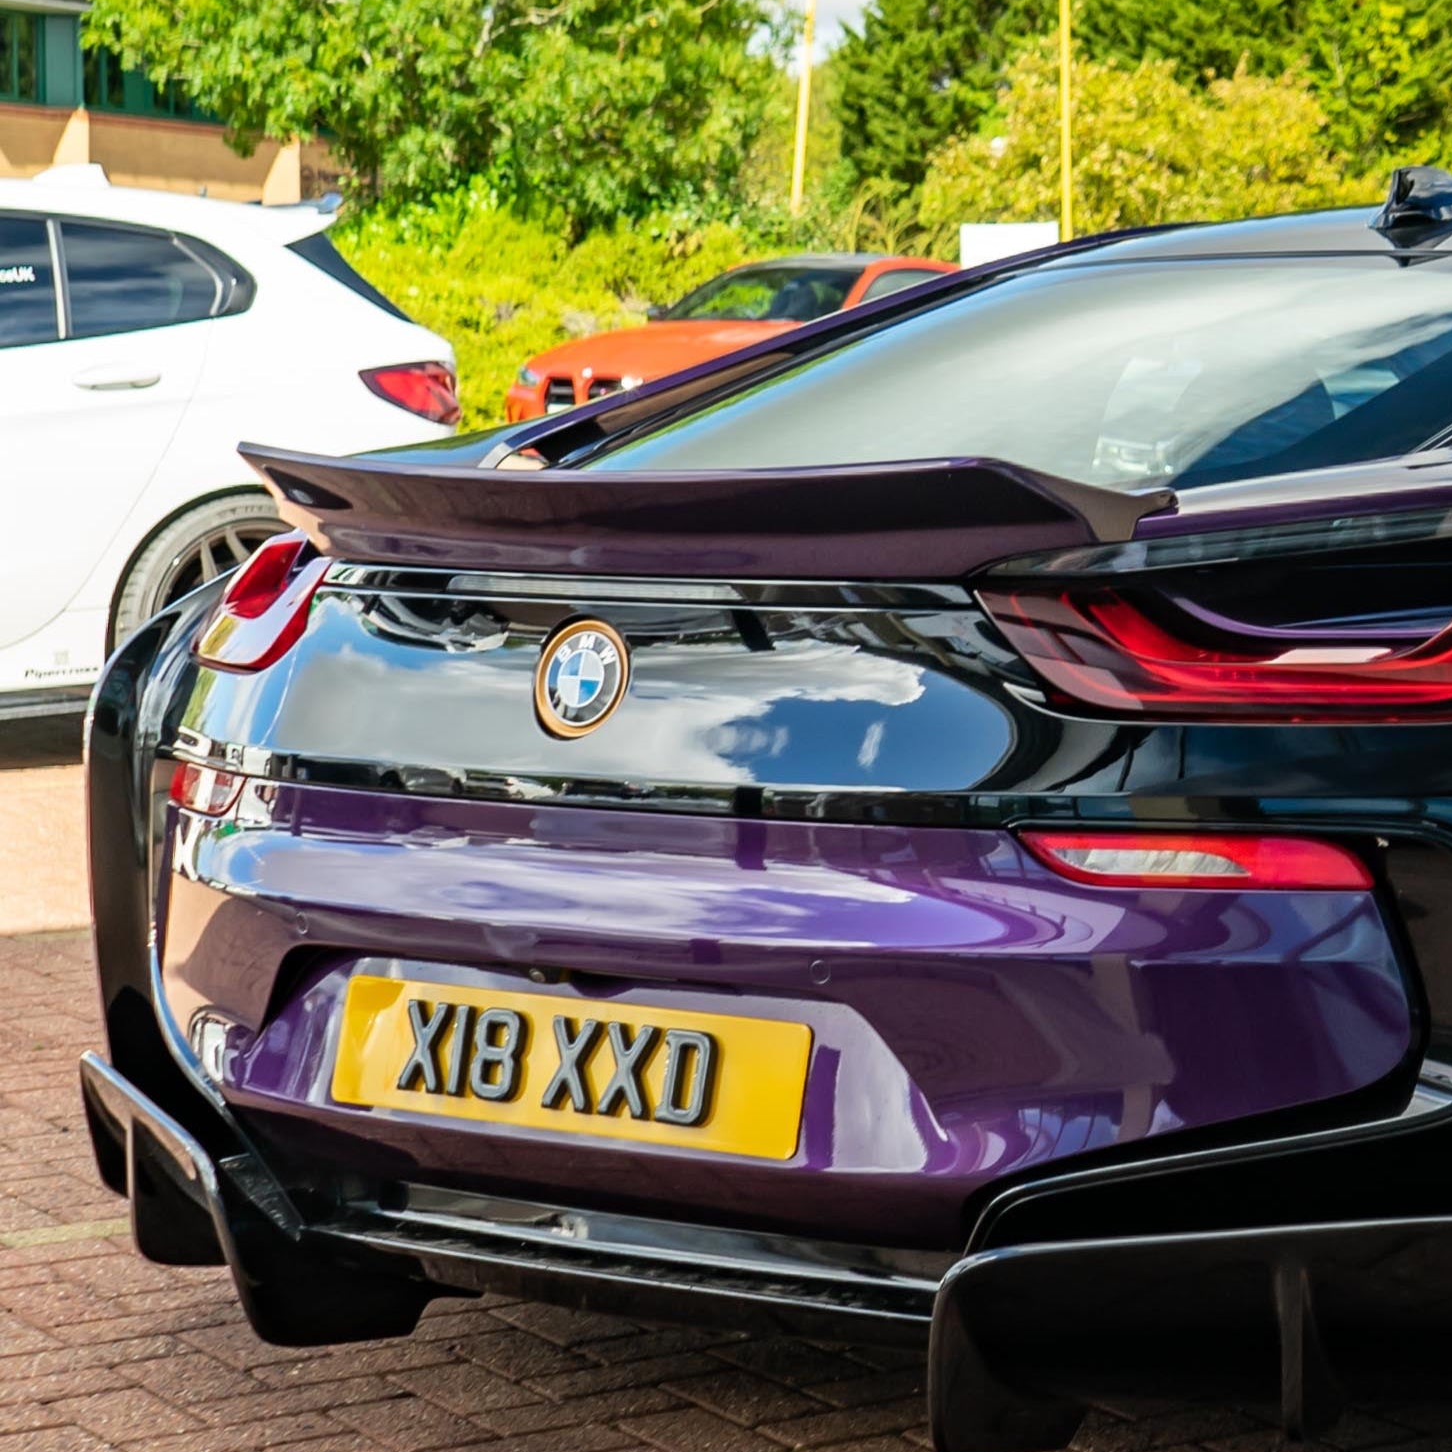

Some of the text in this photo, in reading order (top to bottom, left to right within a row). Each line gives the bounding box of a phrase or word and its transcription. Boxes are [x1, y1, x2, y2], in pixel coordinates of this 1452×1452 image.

[556, 634, 617, 665] BMW
[397, 998, 719, 1127] X18 XXD
